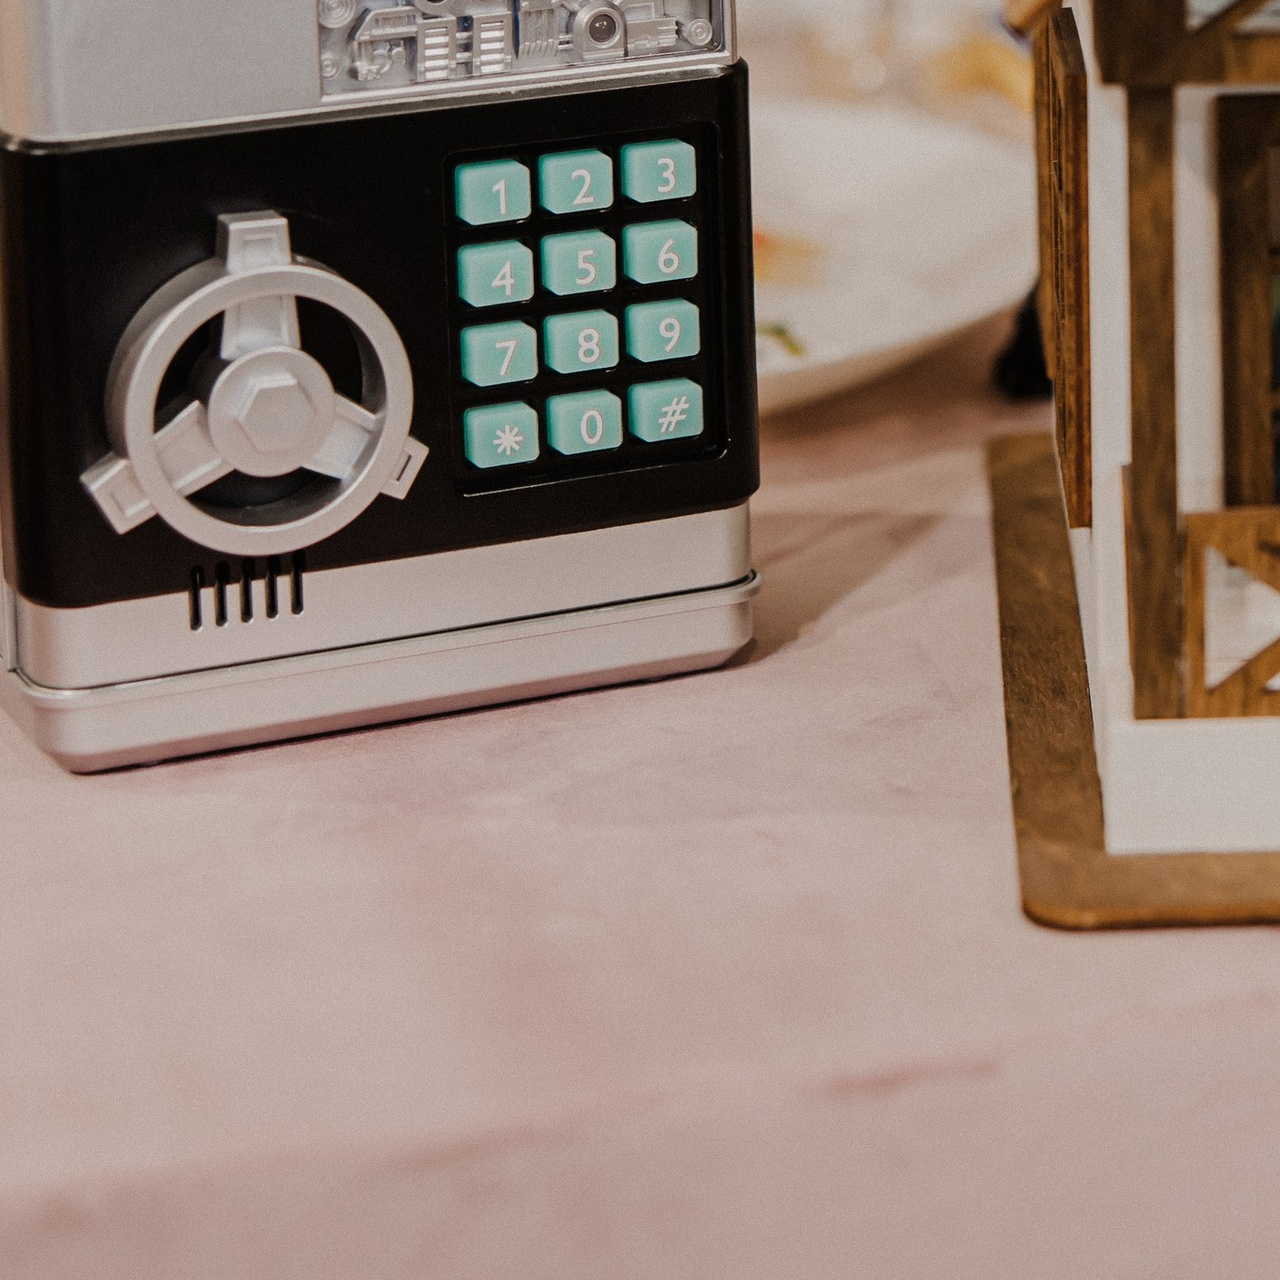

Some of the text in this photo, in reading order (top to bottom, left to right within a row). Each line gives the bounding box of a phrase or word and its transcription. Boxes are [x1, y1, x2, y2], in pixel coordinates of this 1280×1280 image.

[570, 168, 595, 205] 2
[656, 157, 676, 193] 3
[491, 178, 508, 215] 1
[575, 248, 596, 286] 5
[657, 238, 680, 274] 6
[490, 260, 516, 296] 4
[577, 327, 601, 364] 8
[658, 316, 681, 353] 9
[494, 338, 519, 376] 7
[580, 409, 604, 445] 0
